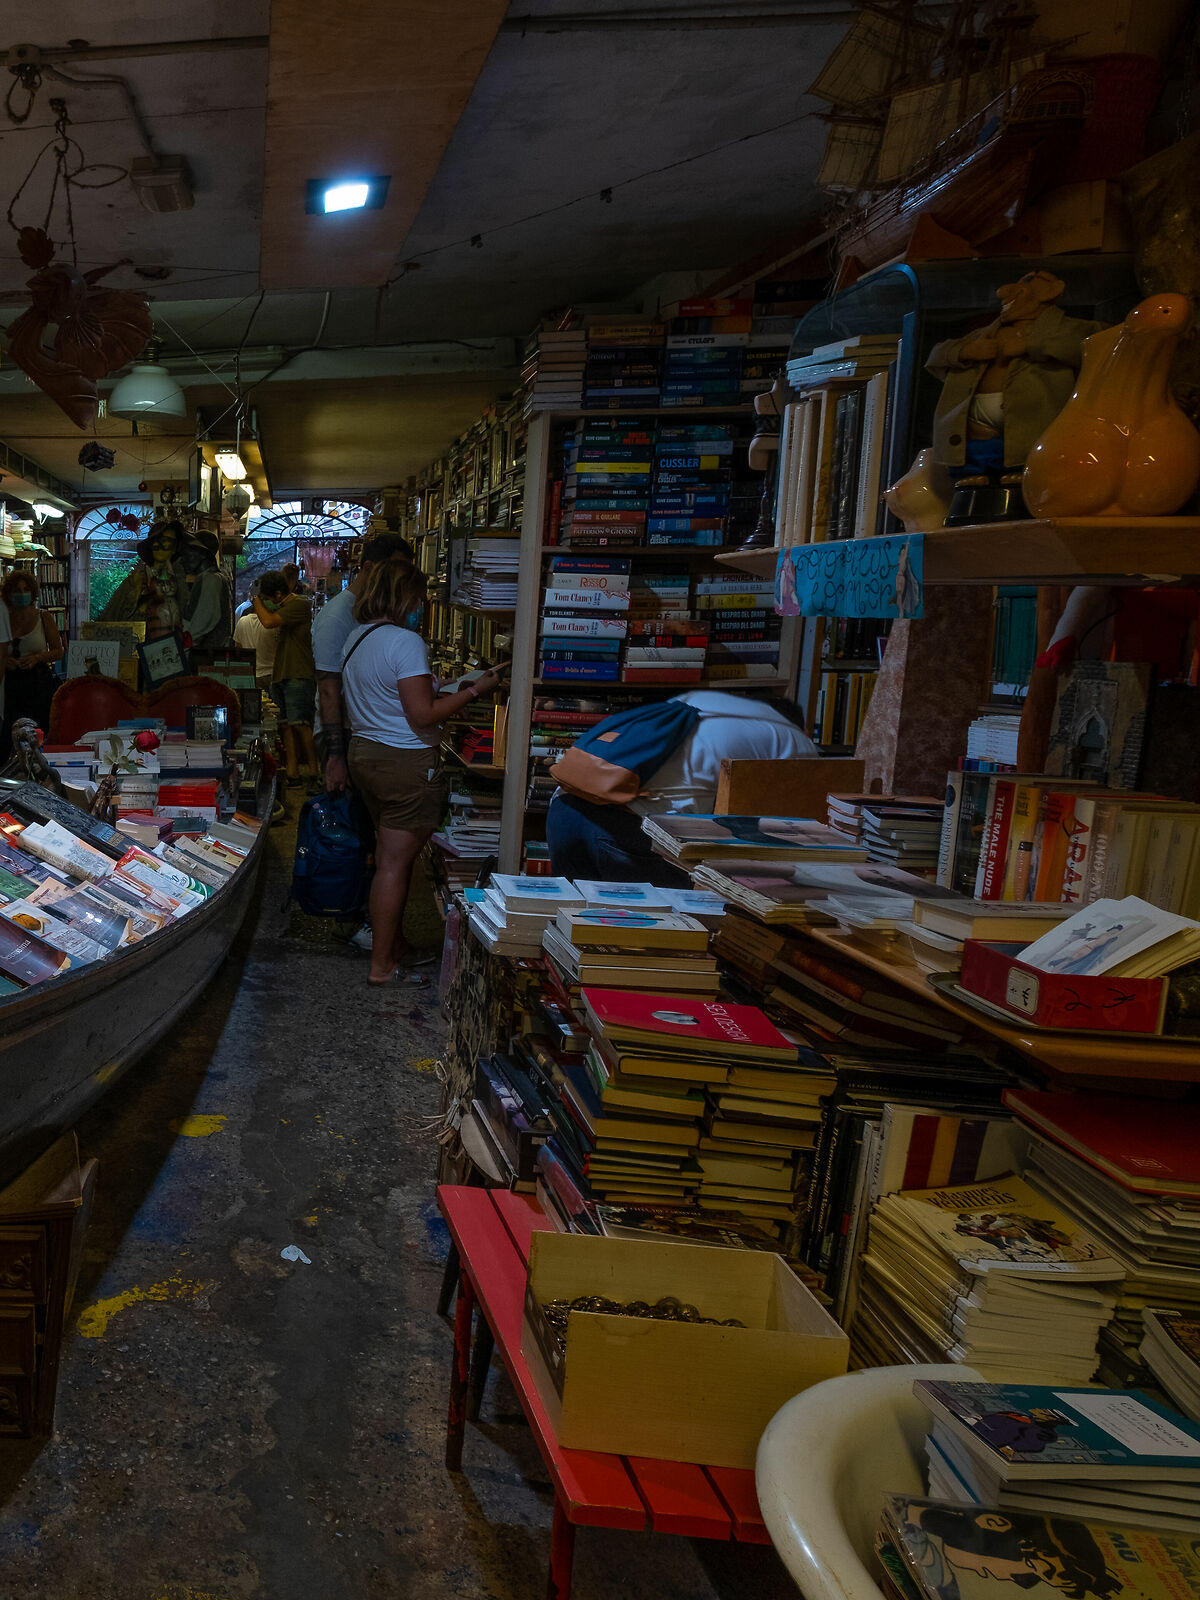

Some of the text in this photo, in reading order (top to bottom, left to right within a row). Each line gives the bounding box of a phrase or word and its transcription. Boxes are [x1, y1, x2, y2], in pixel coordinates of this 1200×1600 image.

[659, 457, 700, 470] CUSSLER
[610, 527, 637, 536] GIORNI
[580, 577, 608, 589] ROSSO
[553, 592, 594, 605] Tom Clancy
[551, 622, 590, 634] Tom Clancy
[71, 645, 116, 658] CORTO
[996, 796, 1006, 817] THE
[939, 811, 953, 877] FORBIDDEN
[989, 822, 1002, 858] MALE
[1062, 818, 1090, 903] ARAK
[982, 860, 996, 896] NUDE
[704, 1002, 753, 1042] SEX DESIGN
[871, 1145, 883, 1187] STORIA
